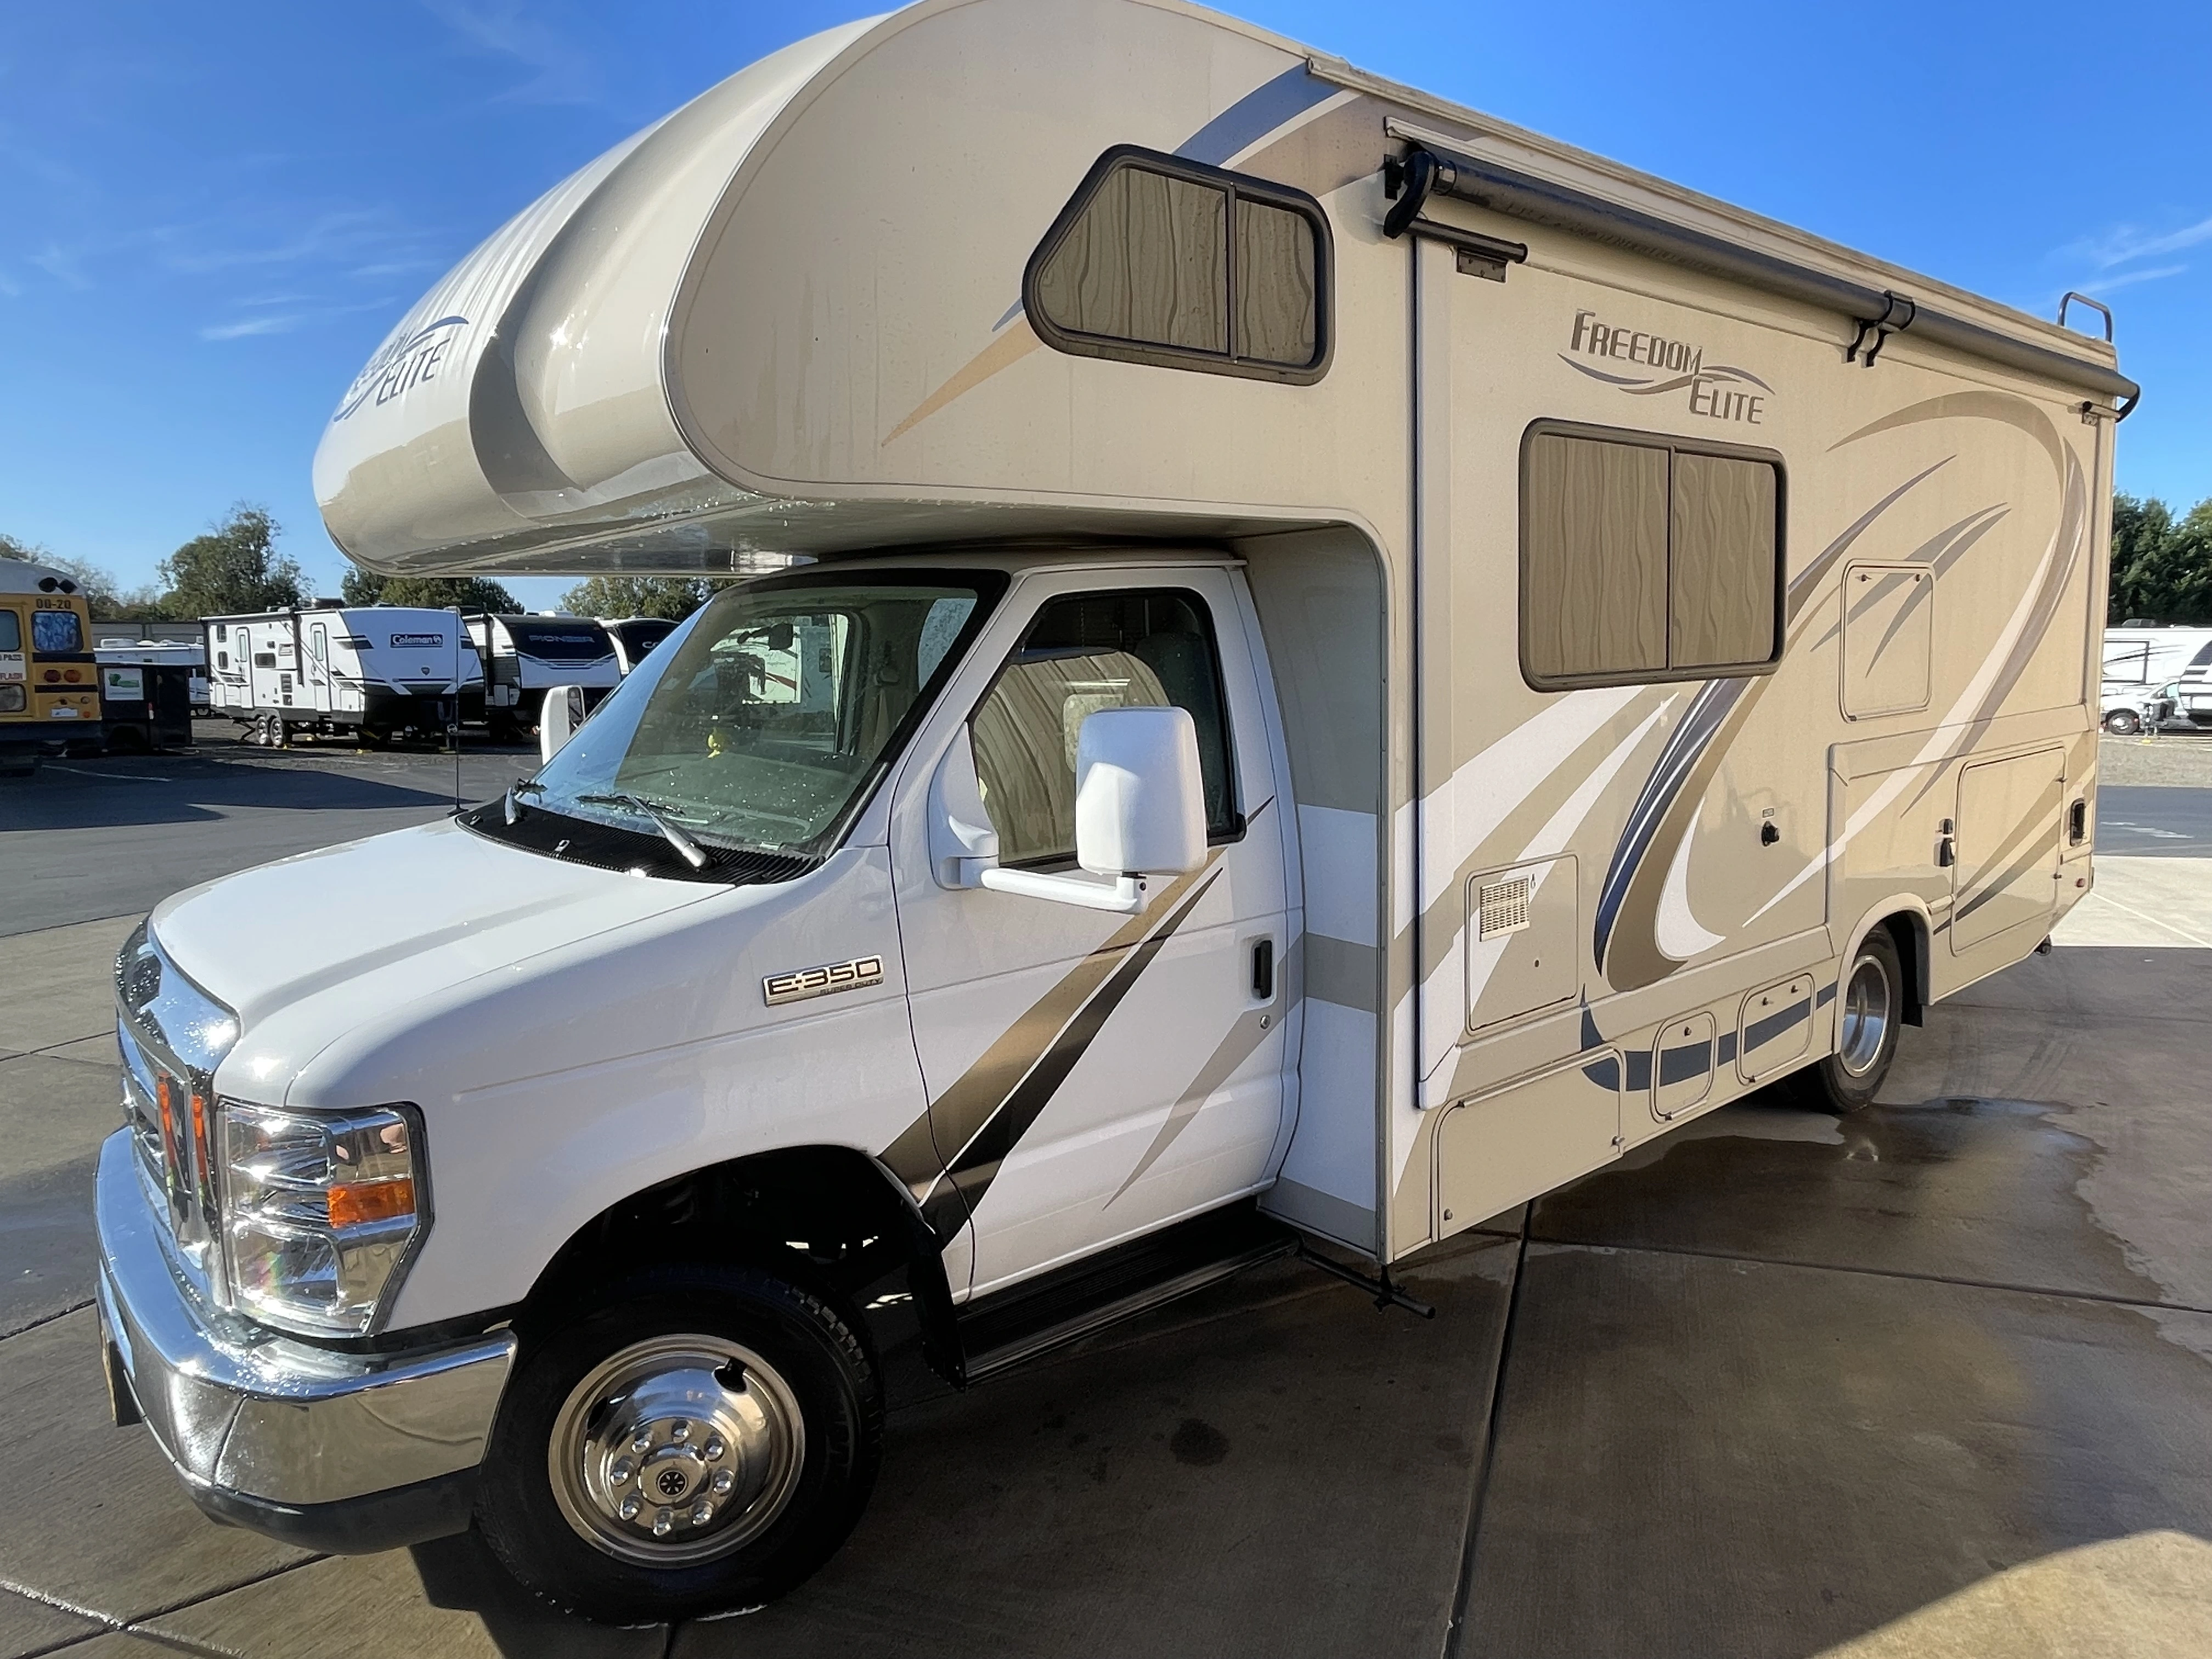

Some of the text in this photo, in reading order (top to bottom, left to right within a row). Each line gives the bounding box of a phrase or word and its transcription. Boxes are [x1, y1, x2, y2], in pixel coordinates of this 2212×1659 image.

[1570, 308, 1703, 375] FREEDOM
[376, 337, 450, 407] ELITE
[1689, 375, 1764, 425] ELITE
[393, 635, 433, 644] Coleman
[768, 958, 881, 996] E-350
